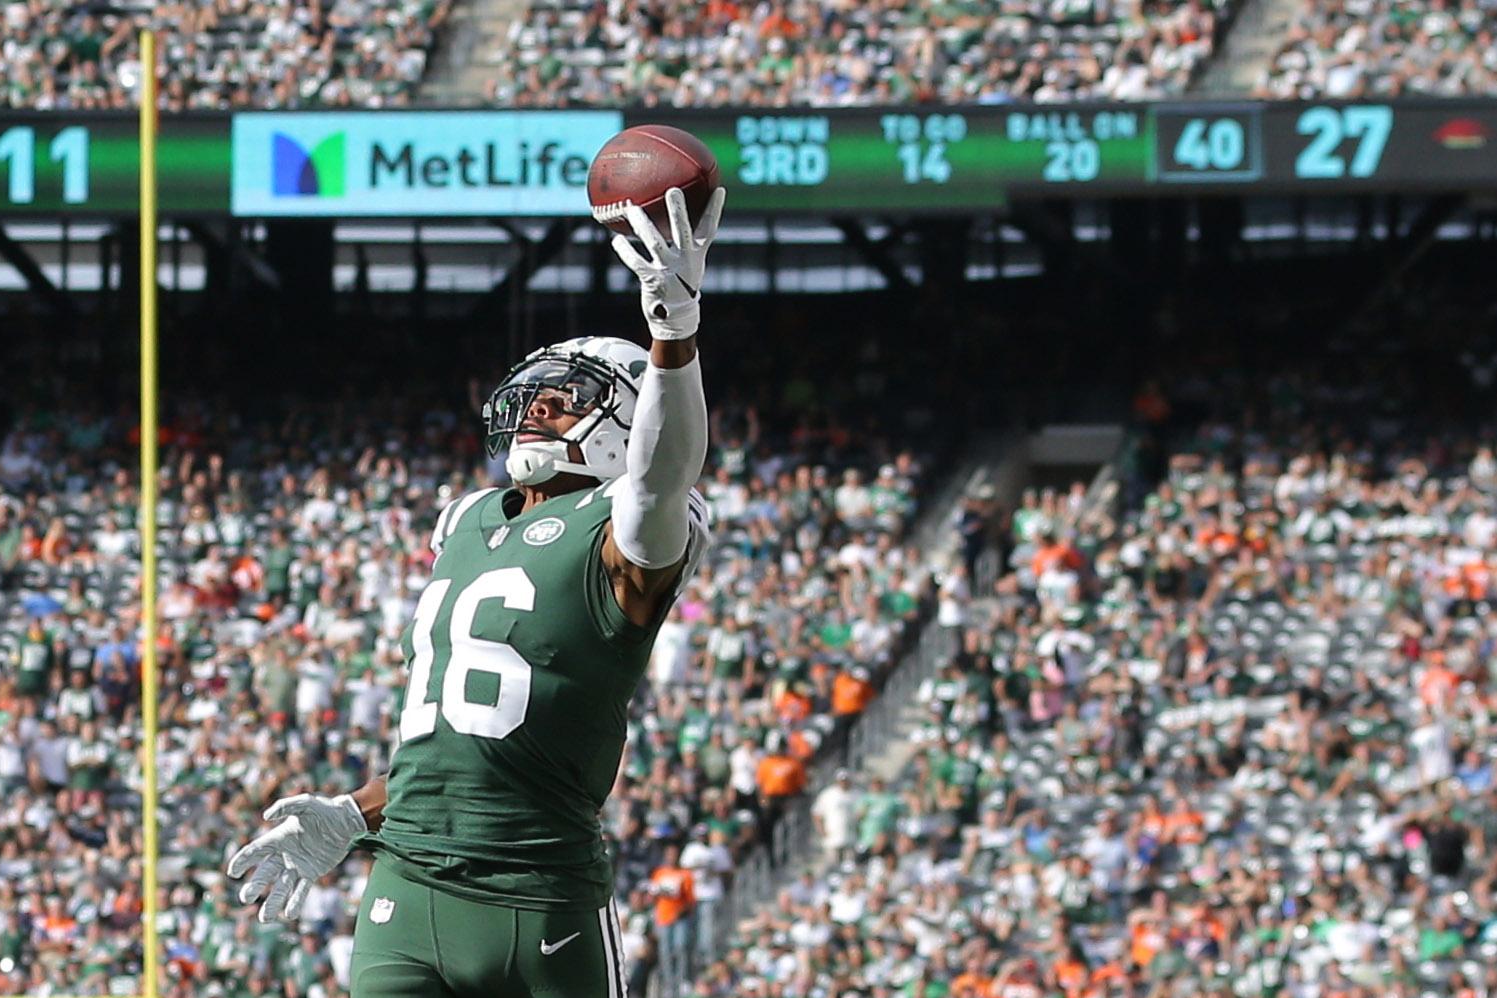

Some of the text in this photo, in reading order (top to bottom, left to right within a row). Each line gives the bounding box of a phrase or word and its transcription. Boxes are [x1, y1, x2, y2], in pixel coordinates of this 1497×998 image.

[1006, 112, 1086, 141] BALL
[1173, 117, 1245, 171] 40
[1294, 104, 1394, 179] 27
[368, 140, 590, 189] MetLife
[739, 144, 830, 185] 3RD
[898, 144, 952, 184] 14
[1044, 139, 1101, 182] 20
[400, 566, 537, 741] 16
